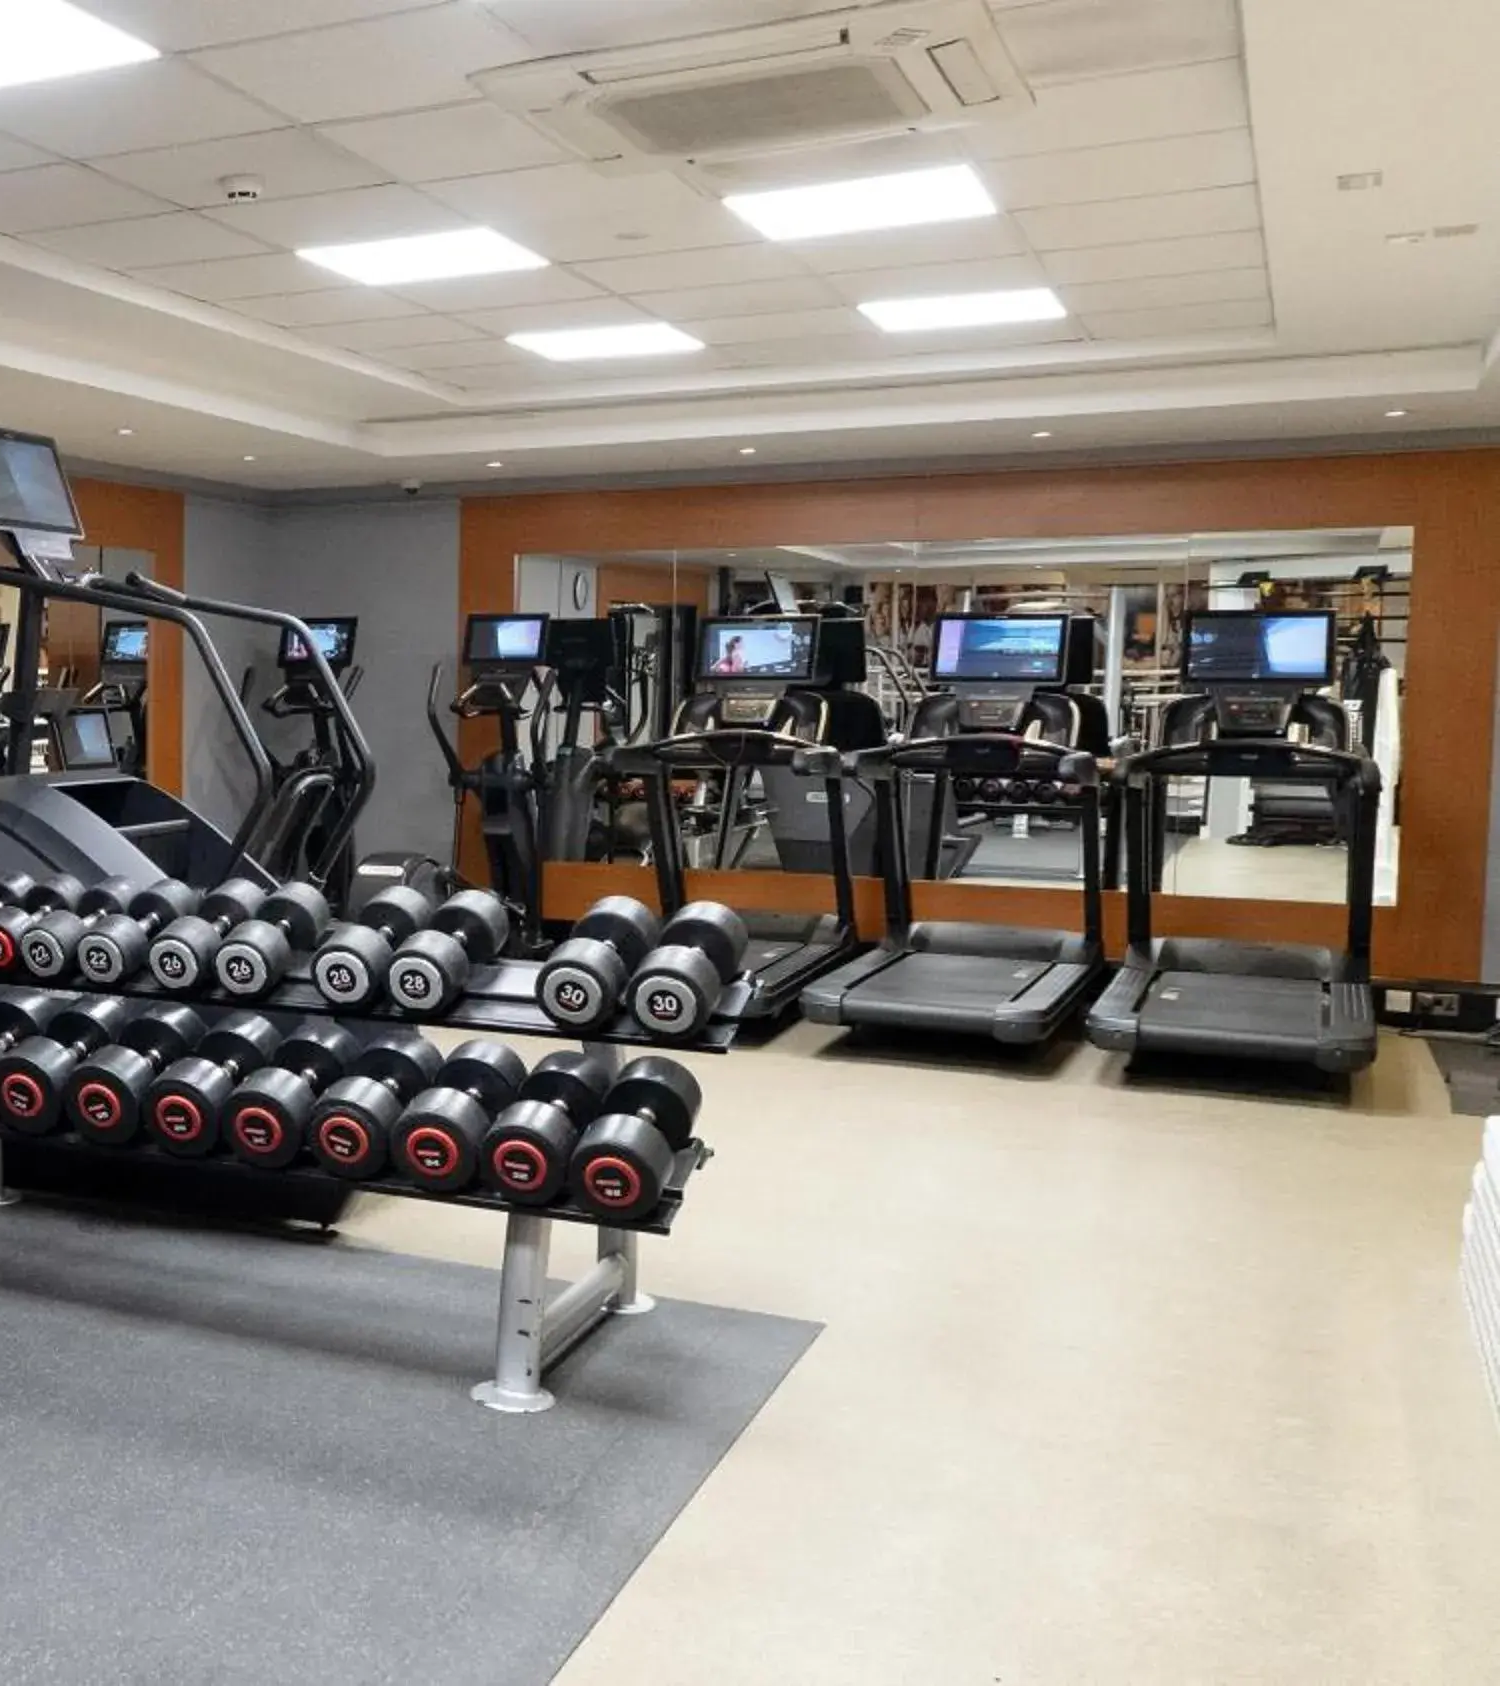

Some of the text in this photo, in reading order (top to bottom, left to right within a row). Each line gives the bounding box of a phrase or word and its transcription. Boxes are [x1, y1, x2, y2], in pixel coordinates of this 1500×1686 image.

[89, 951, 107, 965] 22
[163, 956, 182, 972] 26
[229, 962, 250, 978] 26
[329, 970, 351, 985] 28
[404, 975, 426, 991] 28
[561, 986, 585, 1004] 30
[653, 996, 677, 1011] 30
